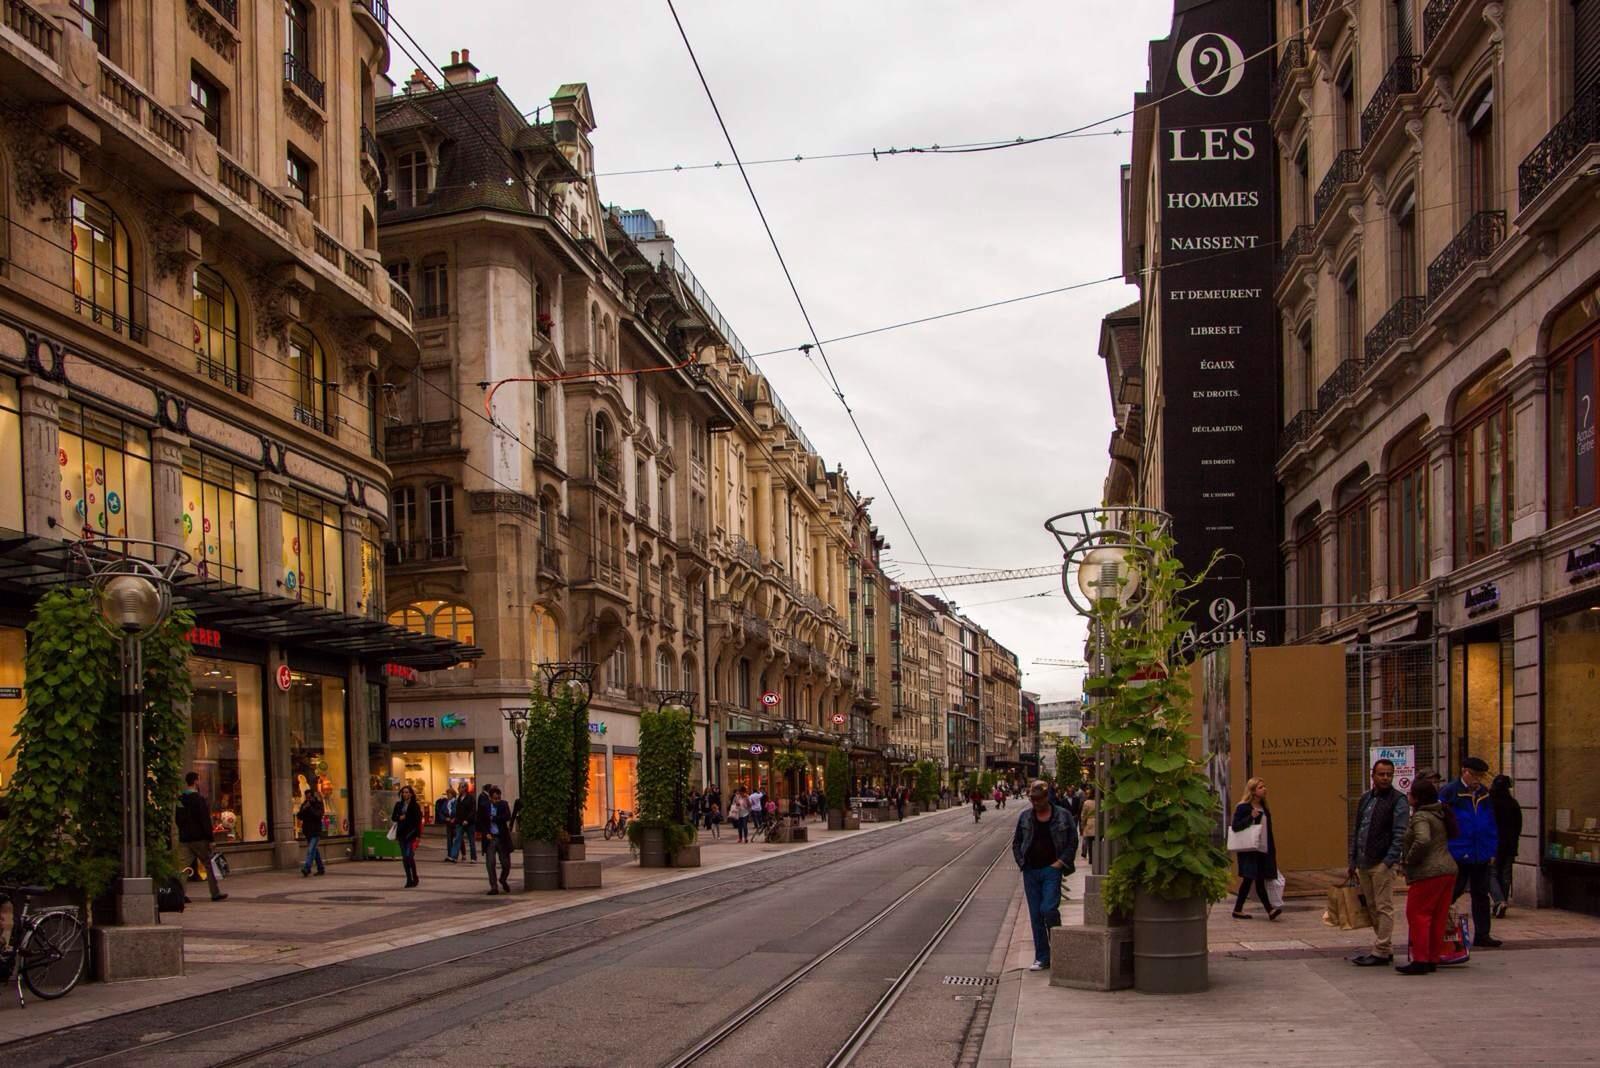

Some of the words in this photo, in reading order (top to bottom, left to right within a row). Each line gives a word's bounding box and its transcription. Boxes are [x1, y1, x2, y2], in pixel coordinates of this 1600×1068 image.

[1168, 127, 1256, 162] LES
[1167, 191, 1260, 208] HOMMES
[1170, 236, 1259, 251] NAISSENT
[1170, 291, 1186, 300] ET
[1188, 288, 1262, 300] DEMEURENT
[1190, 326, 1227, 336] LIBRES
[1228, 325, 1242, 335] ET
[1200, 359, 1235, 370] ÉGAUX
[1192, 391, 1205, 399] EN
[1191, 425, 1243, 433] DÉCLARATION
[1181, 624, 1267, 645] Acuitis
[388, 716, 436, 729] ACOSTE
[1282, 736, 1338, 748] WESTON
